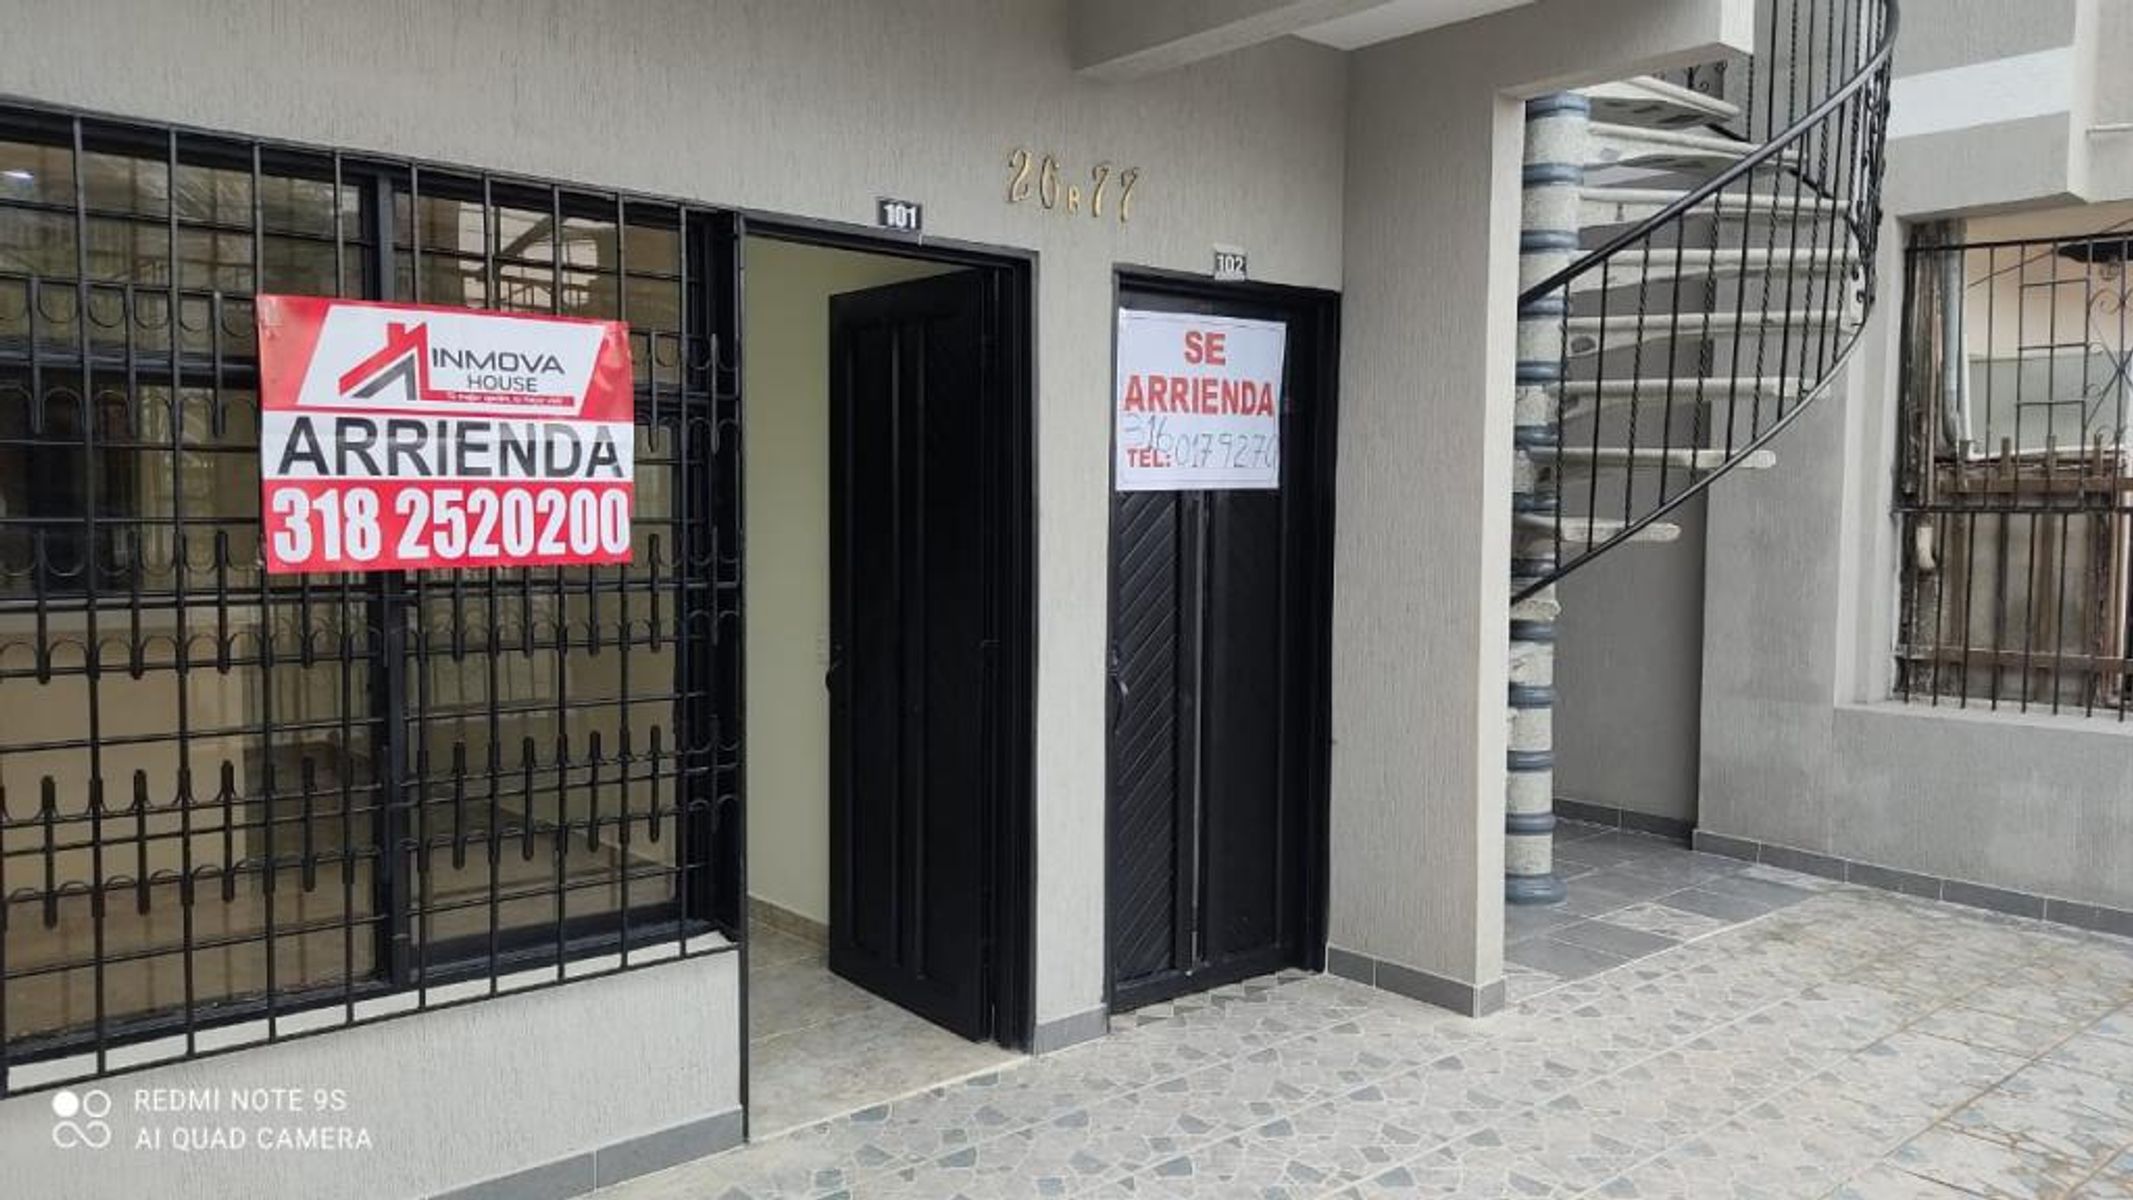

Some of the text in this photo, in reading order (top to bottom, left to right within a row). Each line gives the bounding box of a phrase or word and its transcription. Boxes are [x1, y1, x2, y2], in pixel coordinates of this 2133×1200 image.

[883, 203, 917, 229] 101
[1216, 255, 1244, 275] 102
[432, 347, 566, 375] INMOVA
[1184, 331, 1227, 366] SE
[467, 374, 538, 392] HOUSE
[1124, 375, 1274, 417] ARRIENDA
[277, 415, 625, 479] ARRIENDA
[1127, 448, 1171, 468] TEL:
[272, 486, 631, 564] 318 2520200
